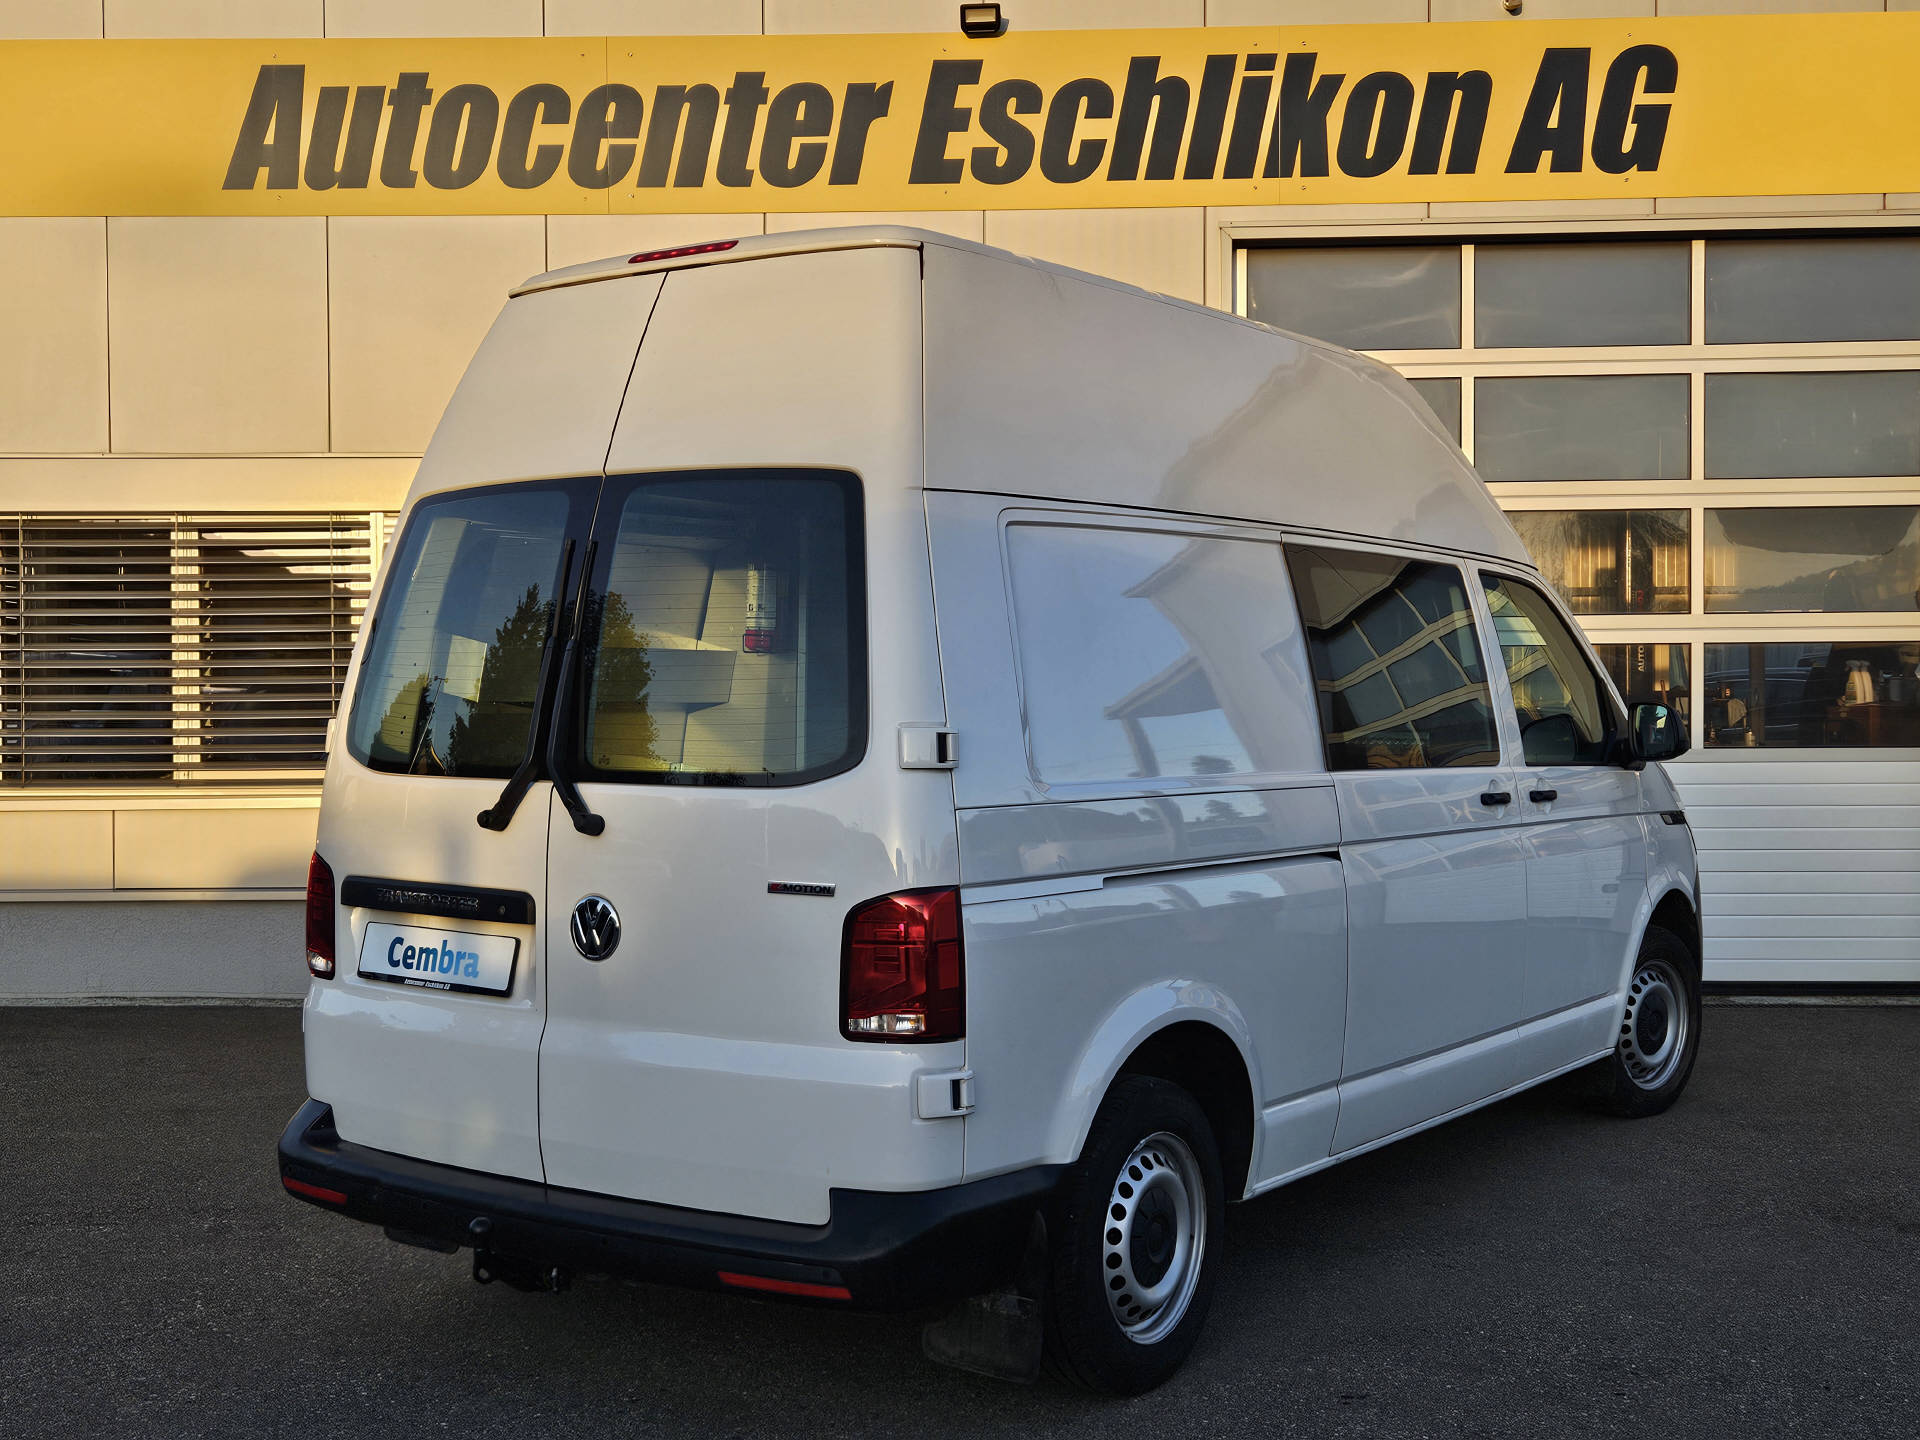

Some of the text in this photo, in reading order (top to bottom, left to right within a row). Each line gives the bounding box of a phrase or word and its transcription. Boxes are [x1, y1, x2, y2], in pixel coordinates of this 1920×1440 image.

[222, 44, 1678, 190] Autocenter Eschlikon AG
[388, 936, 480, 978] Cembra
